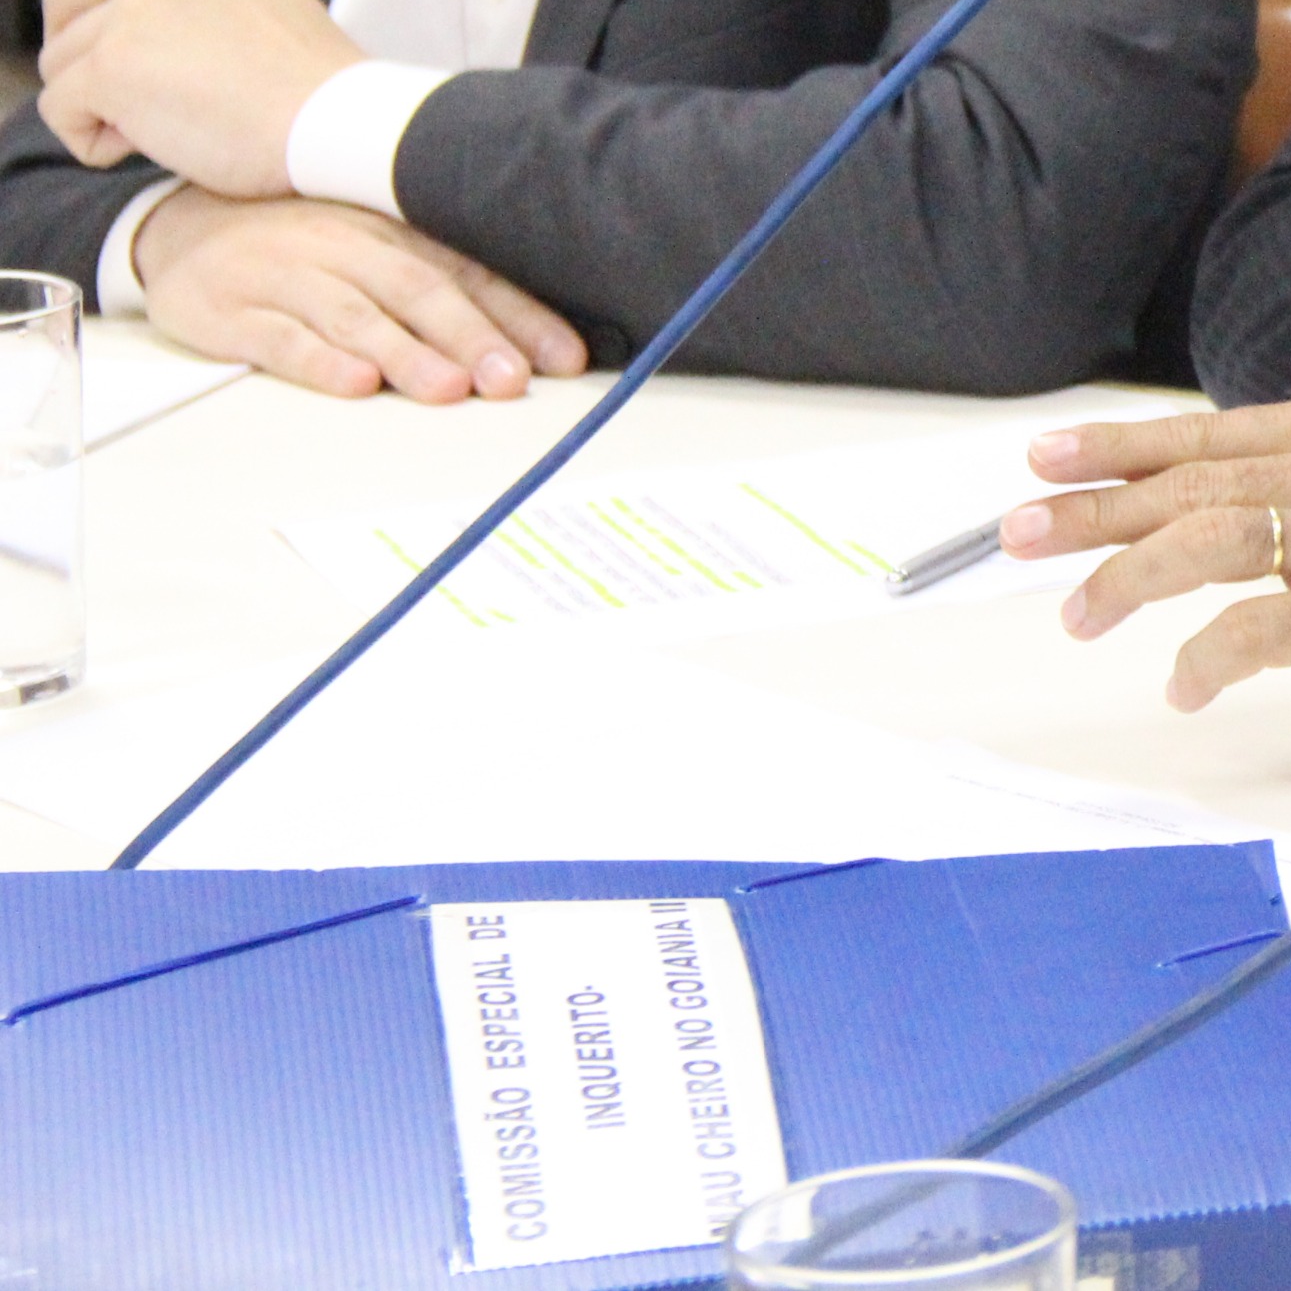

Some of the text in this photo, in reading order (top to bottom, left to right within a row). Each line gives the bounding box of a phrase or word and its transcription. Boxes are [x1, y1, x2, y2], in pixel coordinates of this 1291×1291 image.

[649, 902, 687, 915] II
[654, 919, 708, 1010] GOIANIA
[466, 915, 548, 1241] COMISSÃO ESPECIAL DE
[674, 1018, 717, 1051] NO
[682, 1060, 736, 1160] CHEIRO
